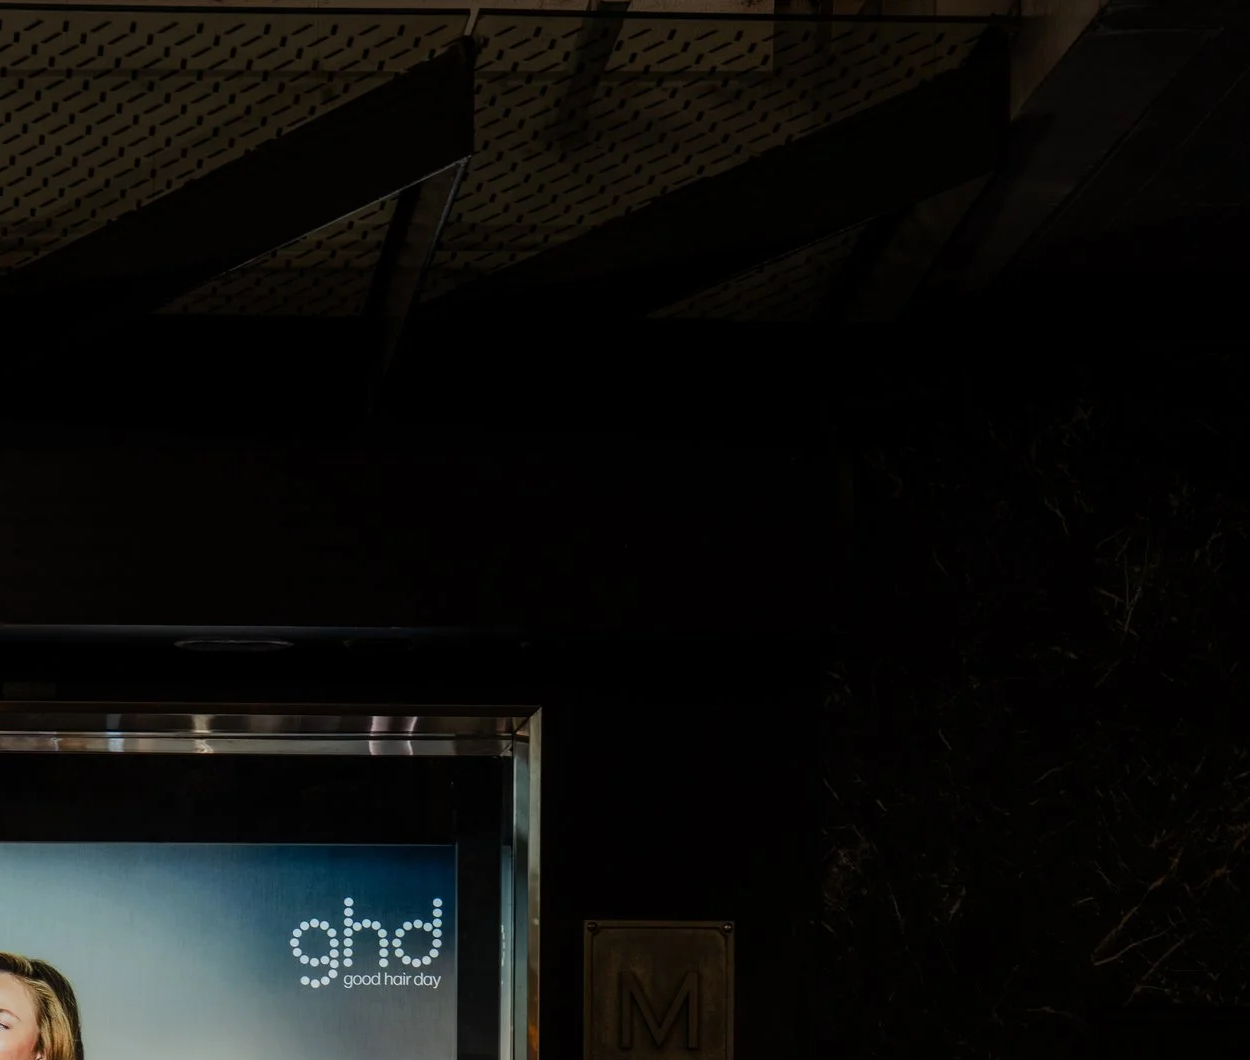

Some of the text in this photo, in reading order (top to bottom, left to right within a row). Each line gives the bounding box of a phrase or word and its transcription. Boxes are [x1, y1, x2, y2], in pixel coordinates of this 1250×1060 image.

[290, 897, 443, 989] ghd
[343, 972, 442, 989] good hair day
